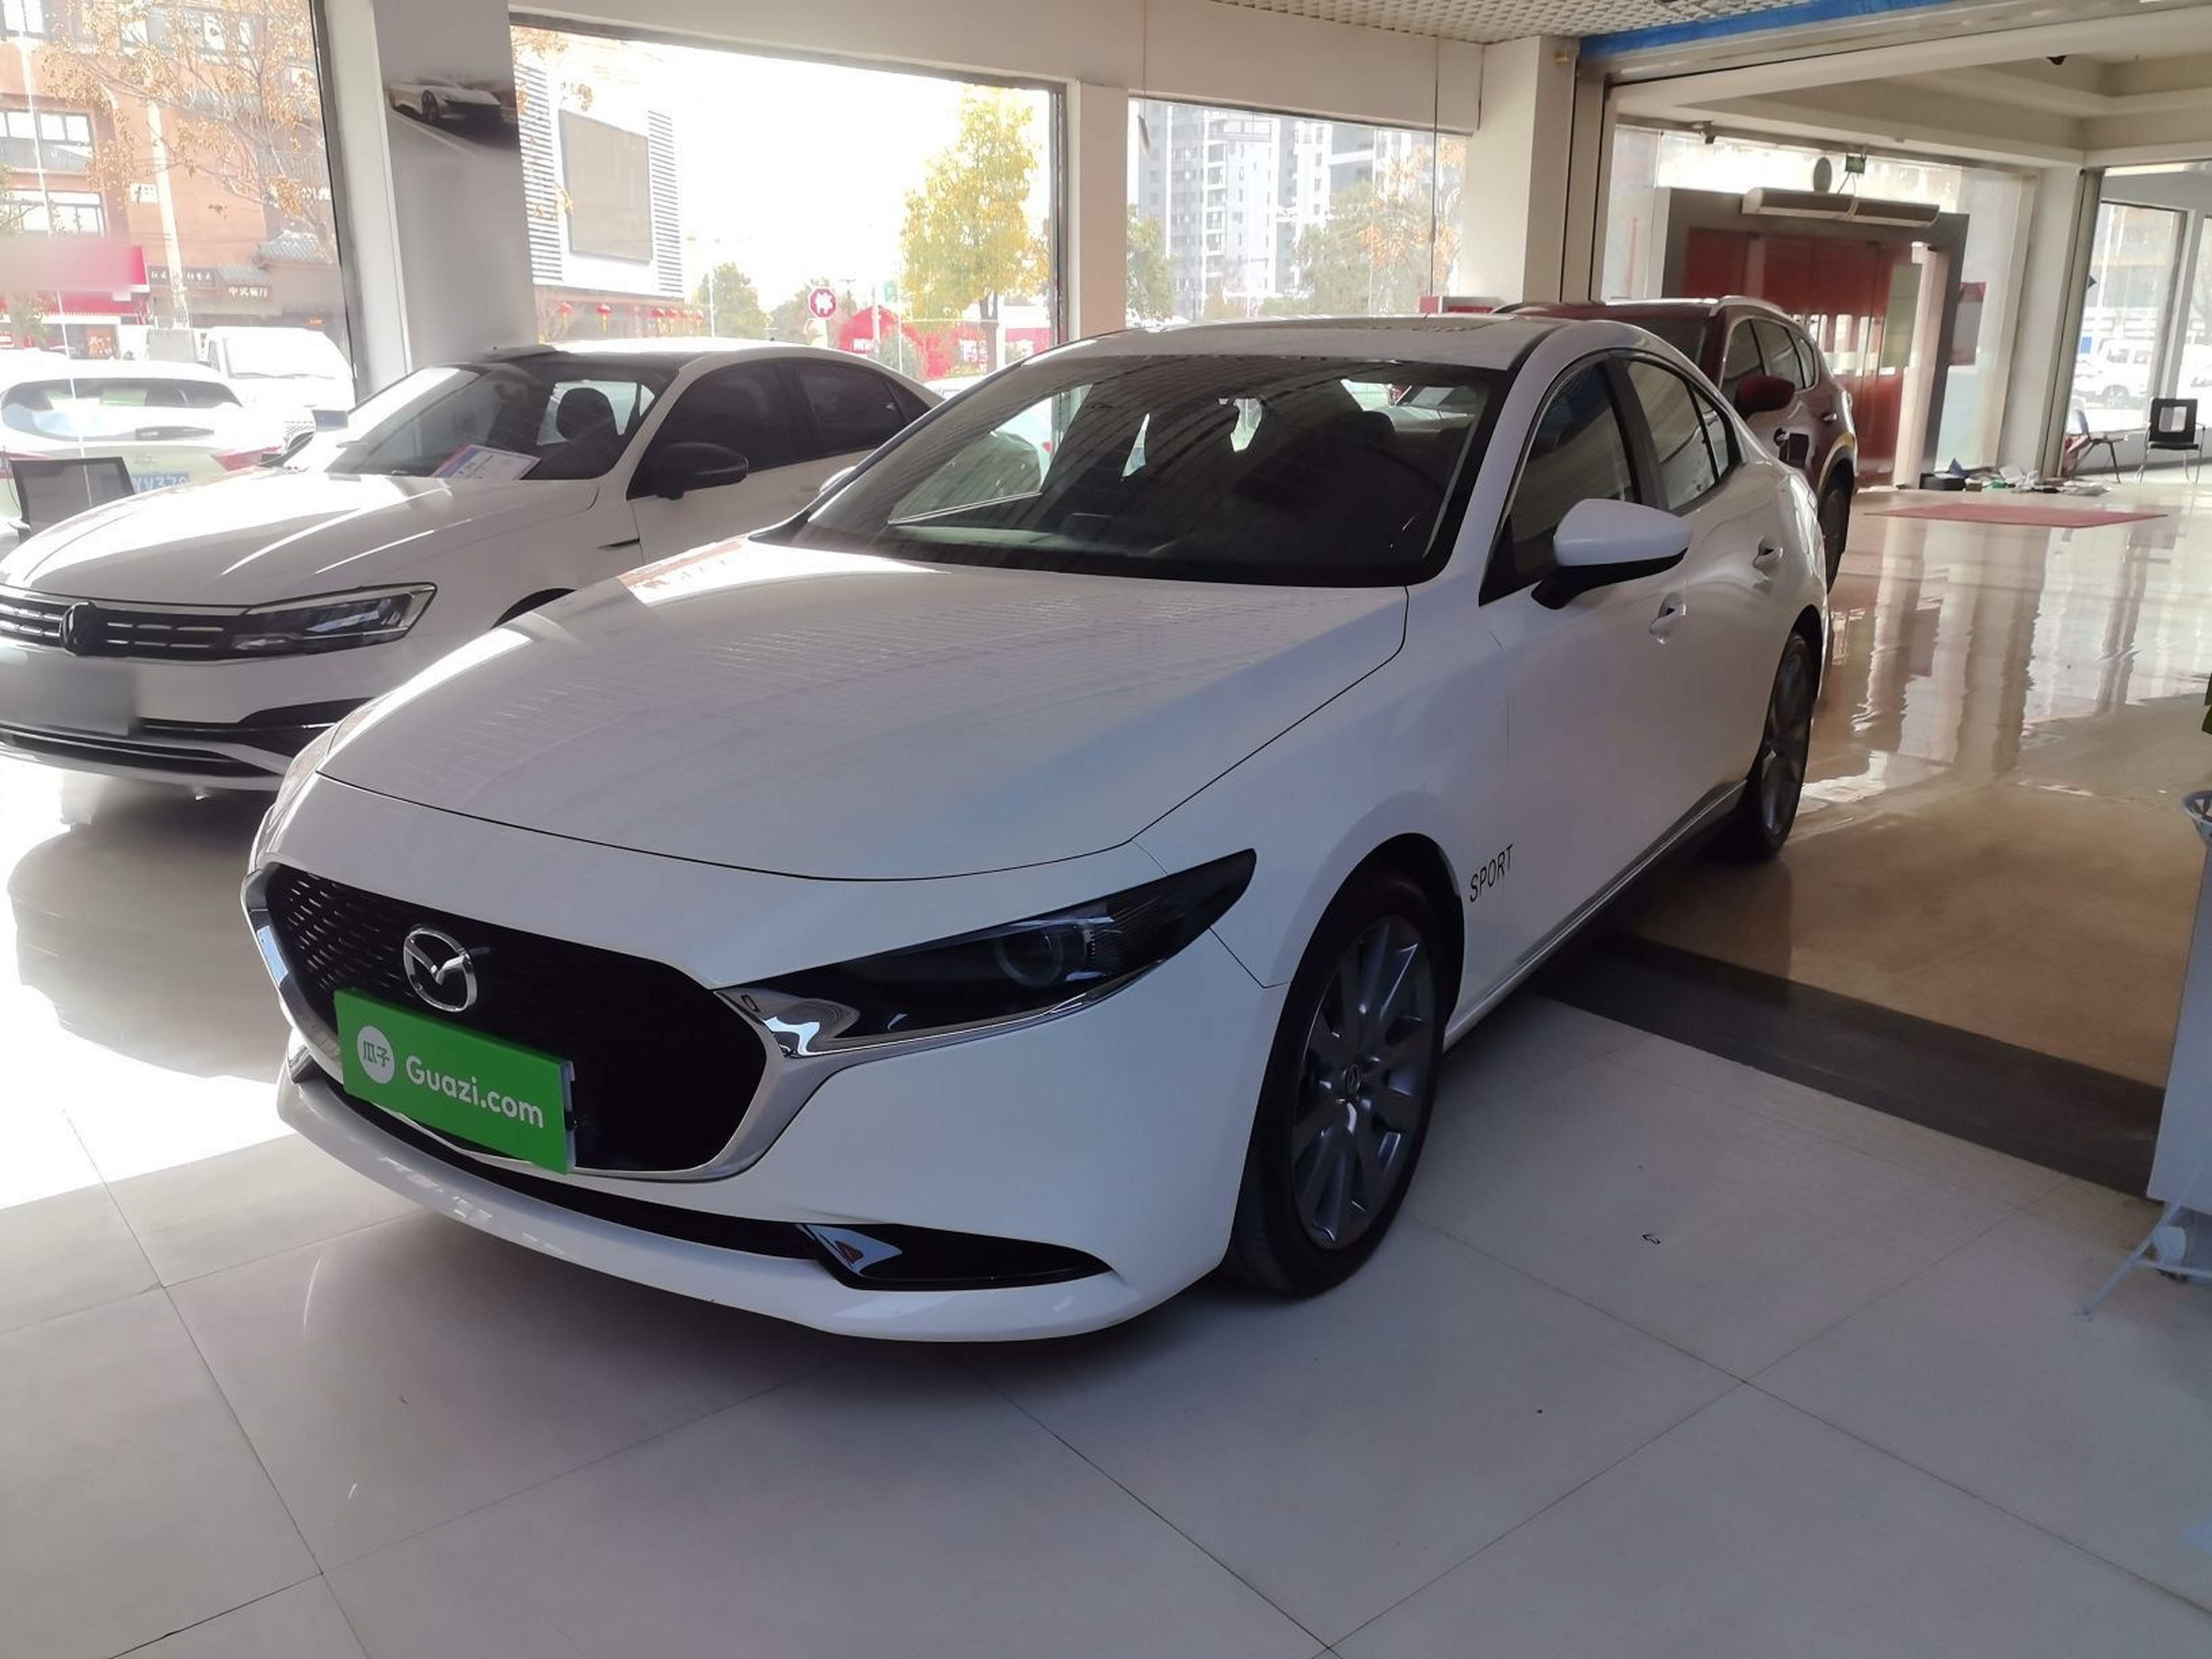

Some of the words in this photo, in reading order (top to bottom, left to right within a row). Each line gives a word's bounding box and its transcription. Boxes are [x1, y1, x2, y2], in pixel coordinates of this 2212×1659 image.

[1470, 844, 1513, 902] SPORT
[362, 1040, 390, 1067] 瓜子
[406, 1055, 543, 1128] Guazi.com
